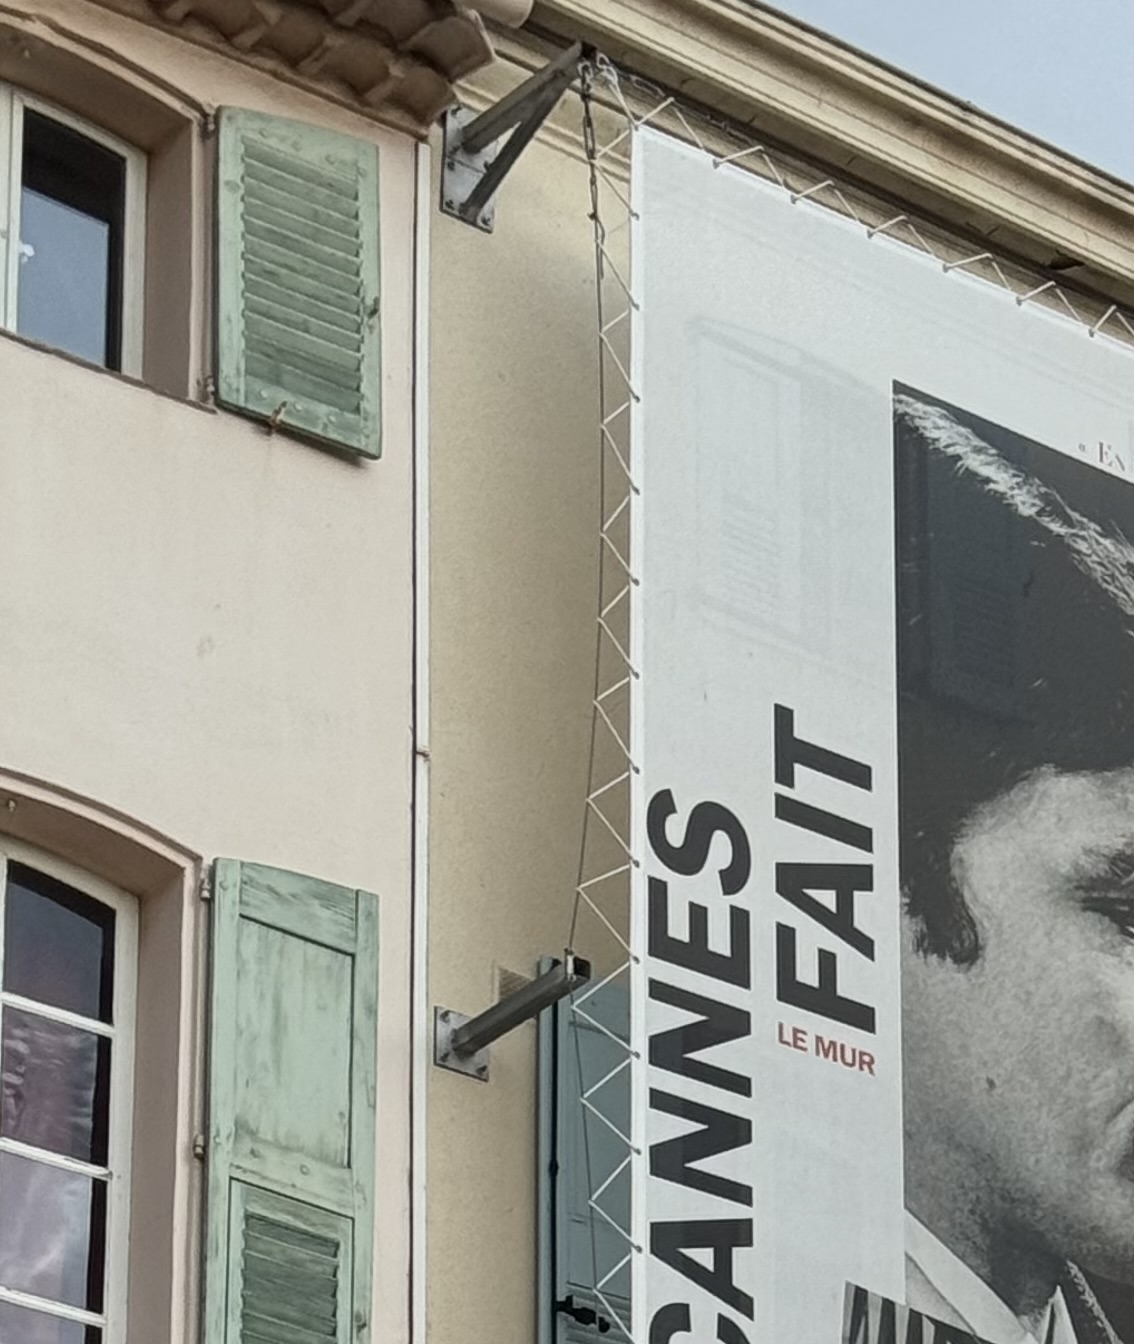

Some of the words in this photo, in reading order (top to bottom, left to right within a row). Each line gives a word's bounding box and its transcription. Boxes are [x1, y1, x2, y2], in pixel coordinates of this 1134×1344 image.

[773, 702, 877, 1035] FAIT
[777, 1021, 808, 1051] LE
[814, 1034, 876, 1077] MUR
